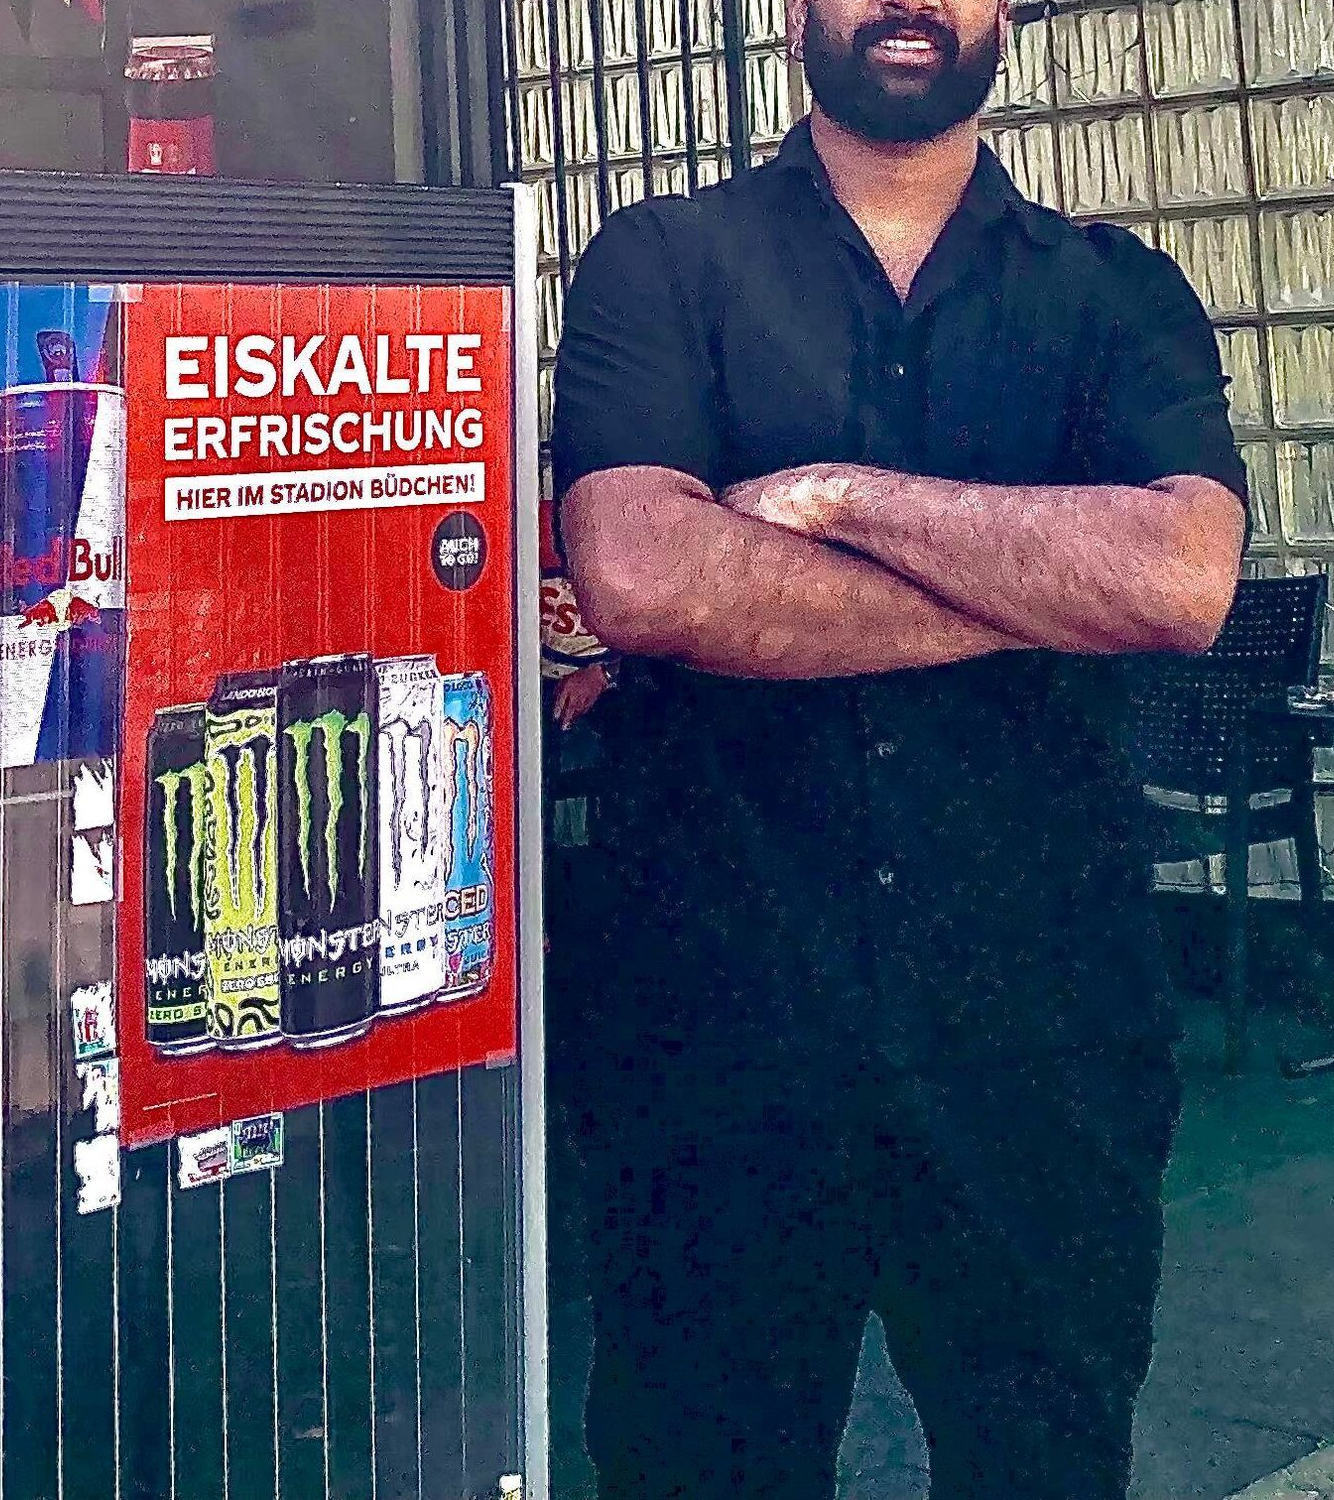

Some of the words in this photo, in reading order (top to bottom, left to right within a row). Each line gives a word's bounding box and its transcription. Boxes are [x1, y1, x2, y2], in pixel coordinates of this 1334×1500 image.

[167, 334, 482, 399] EISKALTE
[165, 409, 484, 461] ERFRISCHUNG
[176, 488, 232, 511] HIER
[238, 485, 264, 506] IM
[270, 479, 364, 505] STADION
[370, 473, 476, 498] BÜDCHEN!
[68, 535, 122, 582] Bull
[439, 537, 479, 554] AUCH
[277, 918, 382, 968] MONSTER
[288, 957, 374, 985] ENERGY
